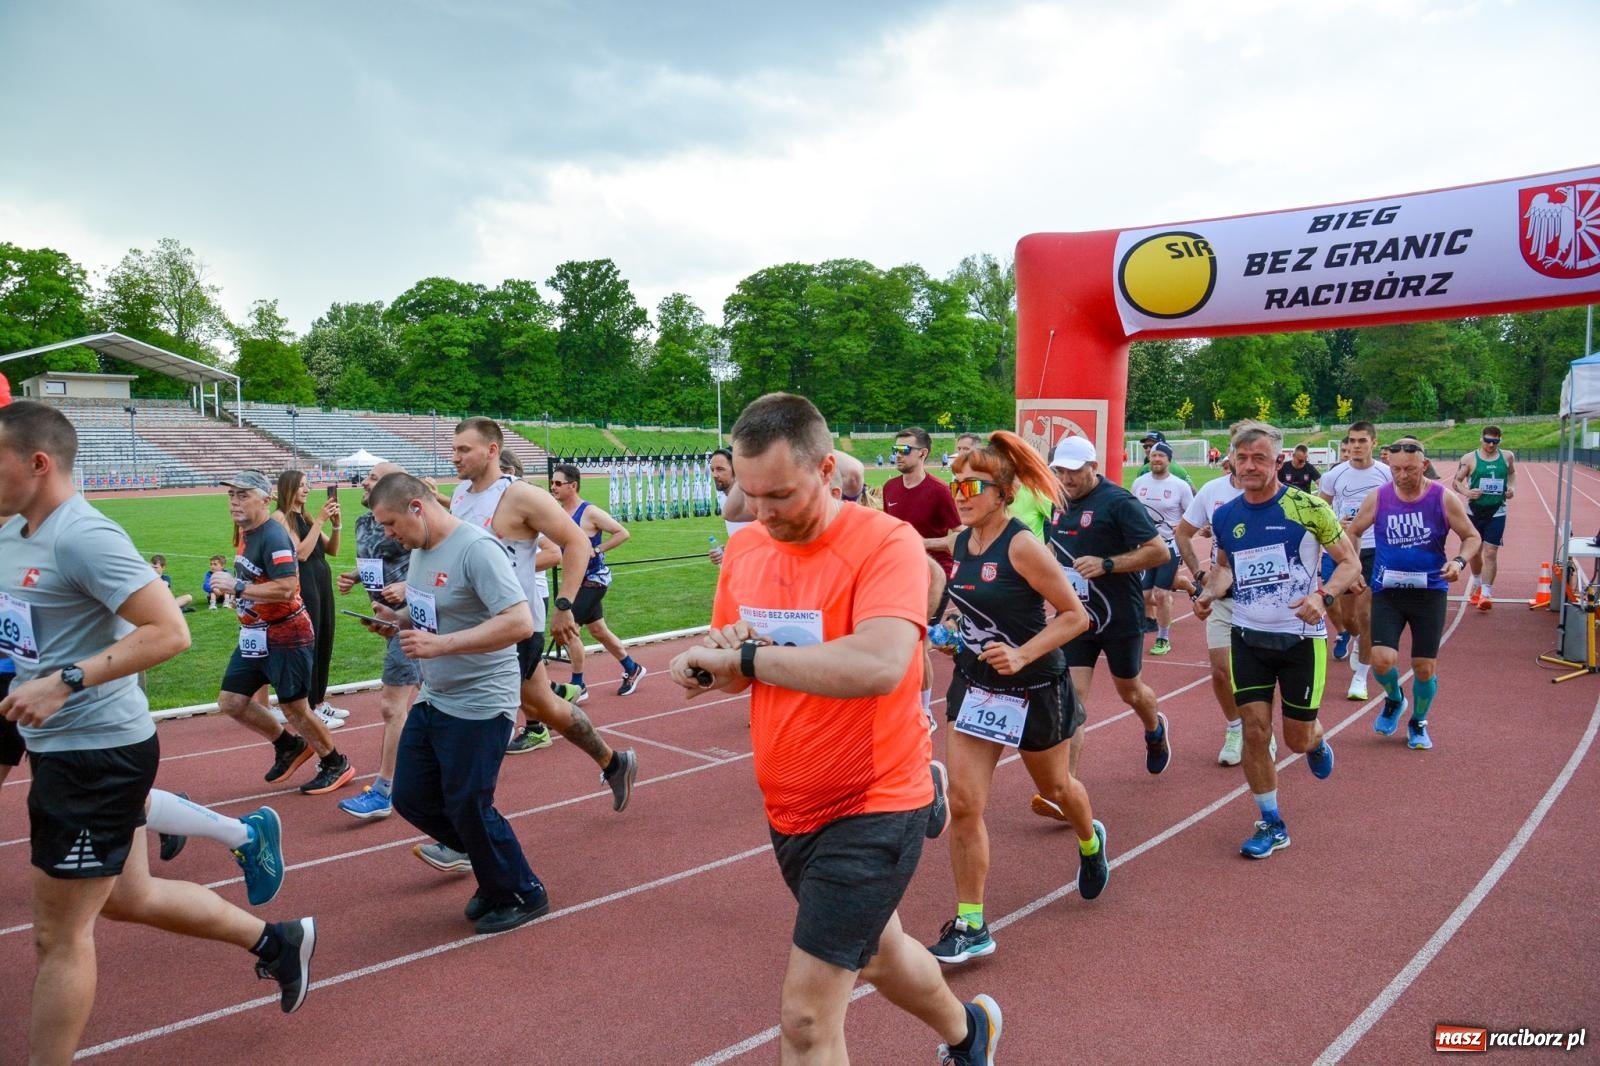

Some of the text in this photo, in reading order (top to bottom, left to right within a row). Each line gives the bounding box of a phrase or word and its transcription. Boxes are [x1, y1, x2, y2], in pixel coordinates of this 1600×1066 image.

[1307, 205, 1402, 234] BIEG
[1165, 239, 1215, 259] SIR
[1243, 228, 1473, 277] BEZ GRANIC
[1264, 270, 1454, 310] RACIBÓRZ
[1387, 512, 1424, 536] RUN
[1248, 561, 1275, 577] 232
[410, 603, 427, 623] 268
[753, 609, 767, 618] BIEG
[768, 611, 783, 619] BEZ
[784, 612, 815, 620] GRANIC
[242, 639, 257, 650] 186
[977, 709, 1007, 730] 194
